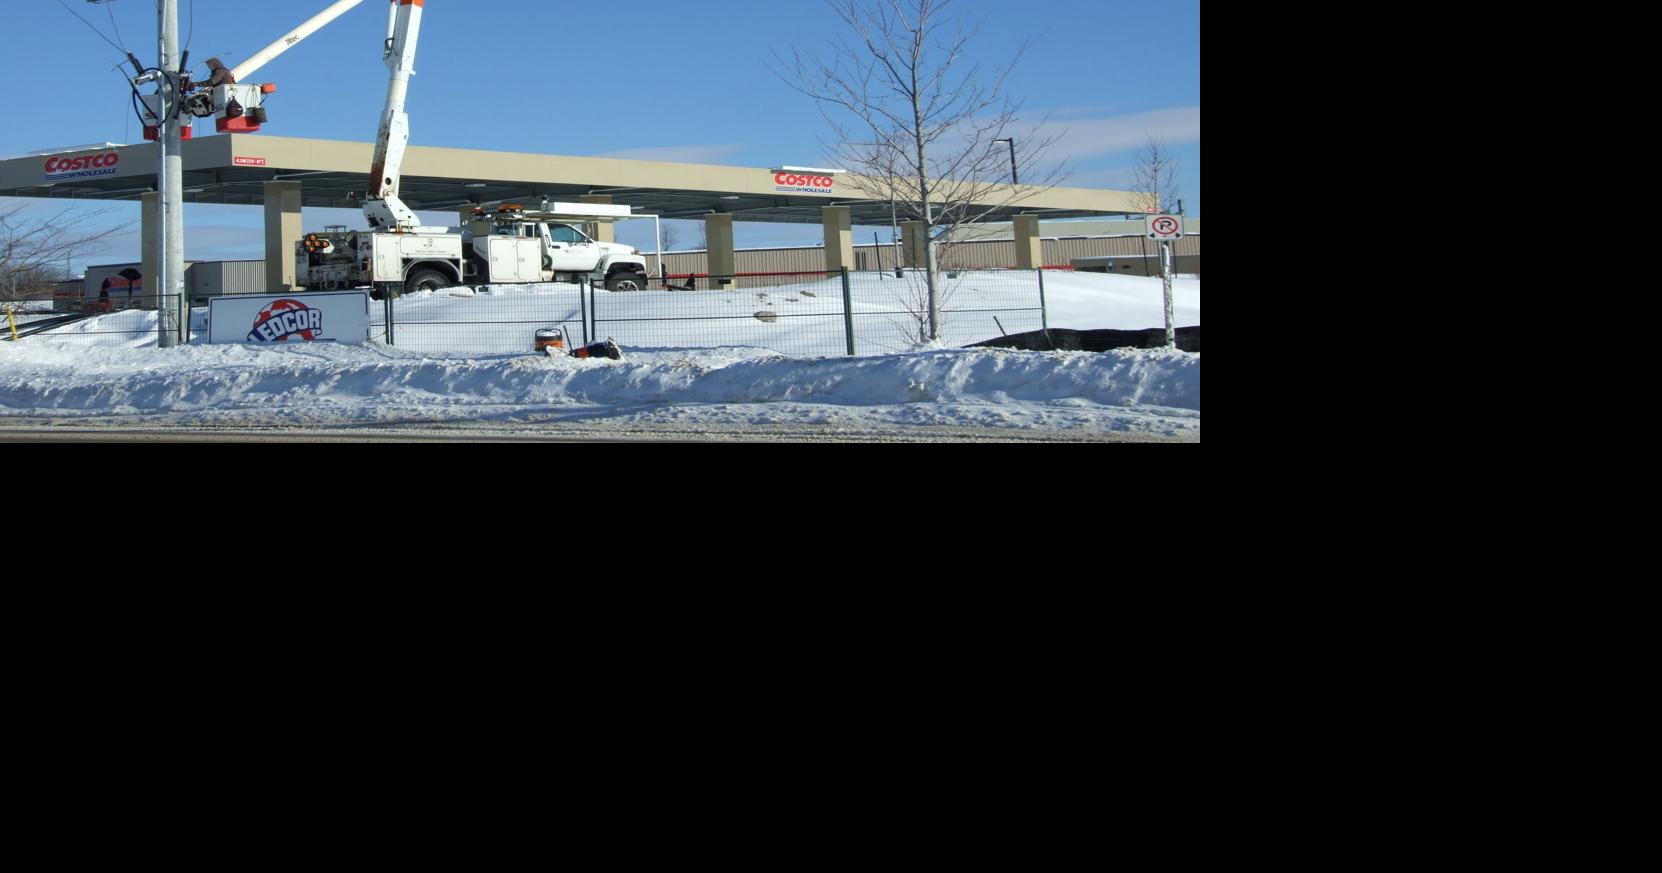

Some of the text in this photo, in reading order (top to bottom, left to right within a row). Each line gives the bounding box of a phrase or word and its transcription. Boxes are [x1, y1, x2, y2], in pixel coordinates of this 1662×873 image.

[45, 152, 119, 173] COSTCO
[70, 168, 117, 178] WHOLESALE
[775, 171, 833, 187] COSTCO
